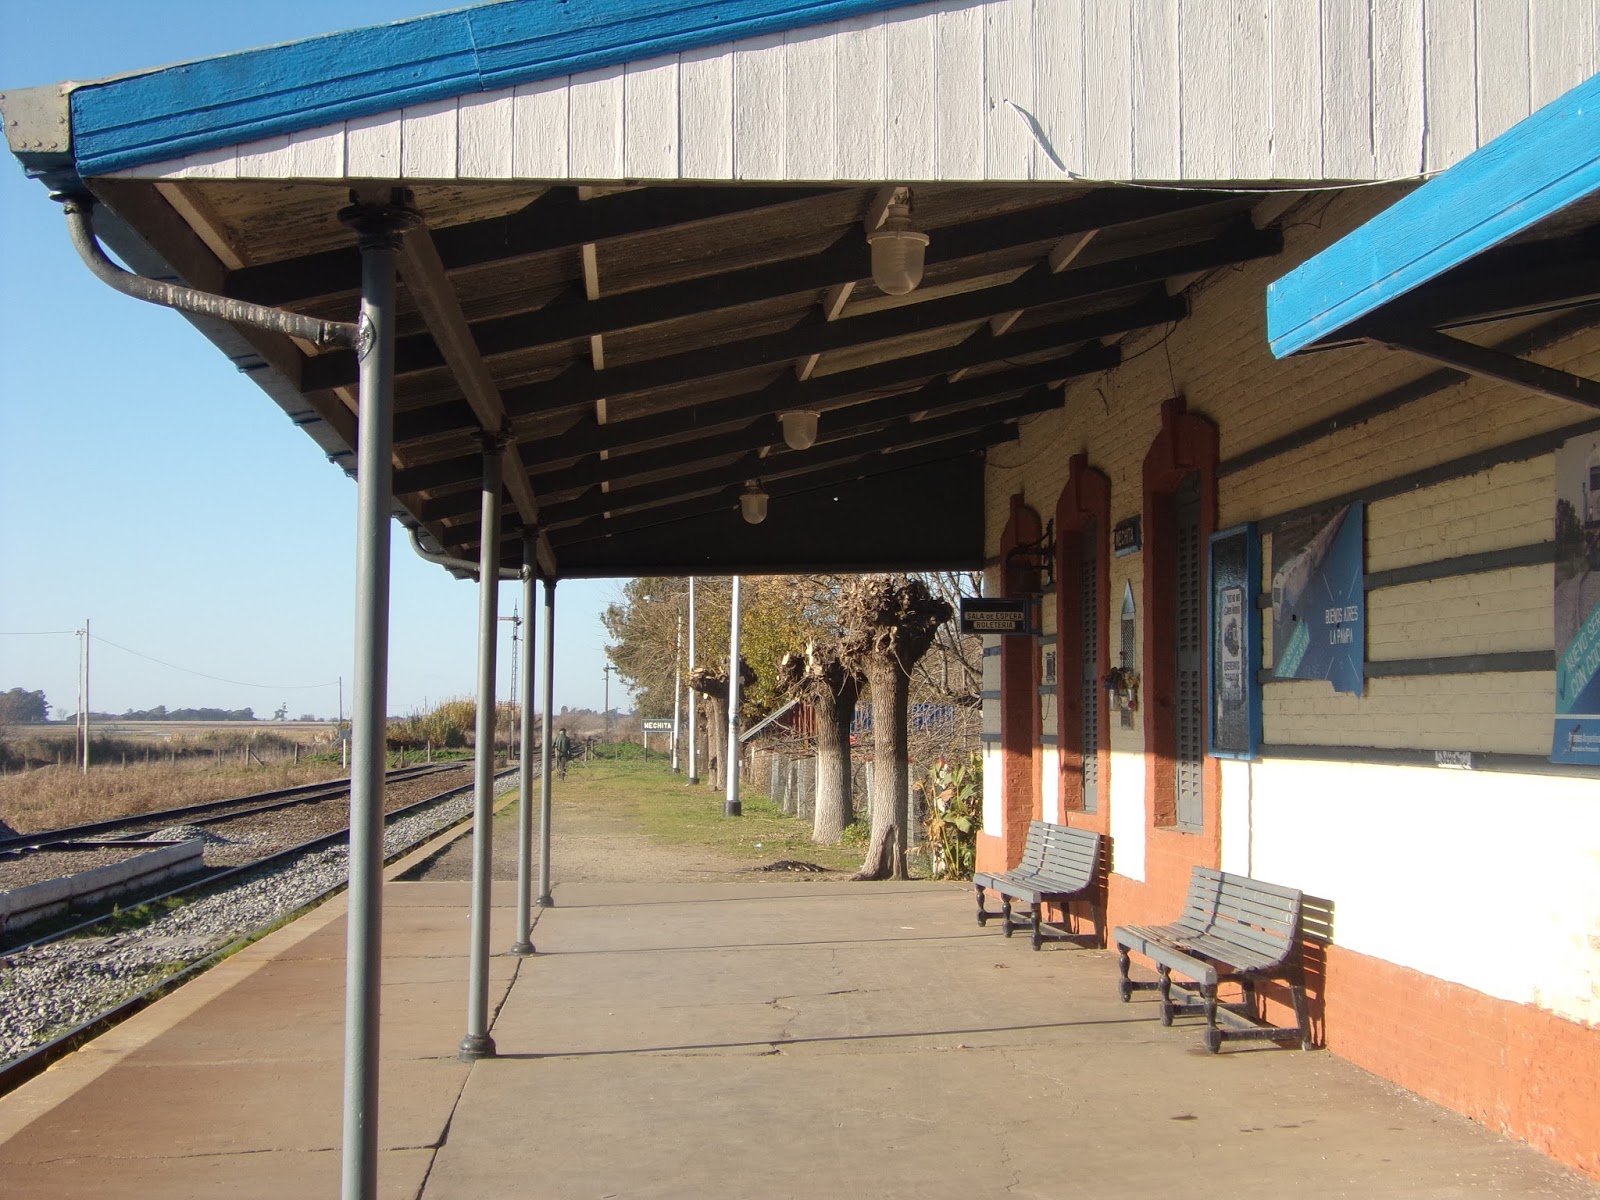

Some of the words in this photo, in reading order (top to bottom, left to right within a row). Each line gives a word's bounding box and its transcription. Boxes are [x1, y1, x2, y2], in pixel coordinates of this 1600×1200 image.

[966, 612, 984, 620] SALA
[995, 612, 1022, 620] ESPERA
[1325, 607, 1342, 624] BUENOS
[1343, 605, 1359, 622] AIRES
[976, 621, 1013, 629] BOLETERIA
[1329, 629, 1337, 645] LA
[1336, 628, 1354, 644] PAMPA
[1571, 666, 1588, 698] CON
